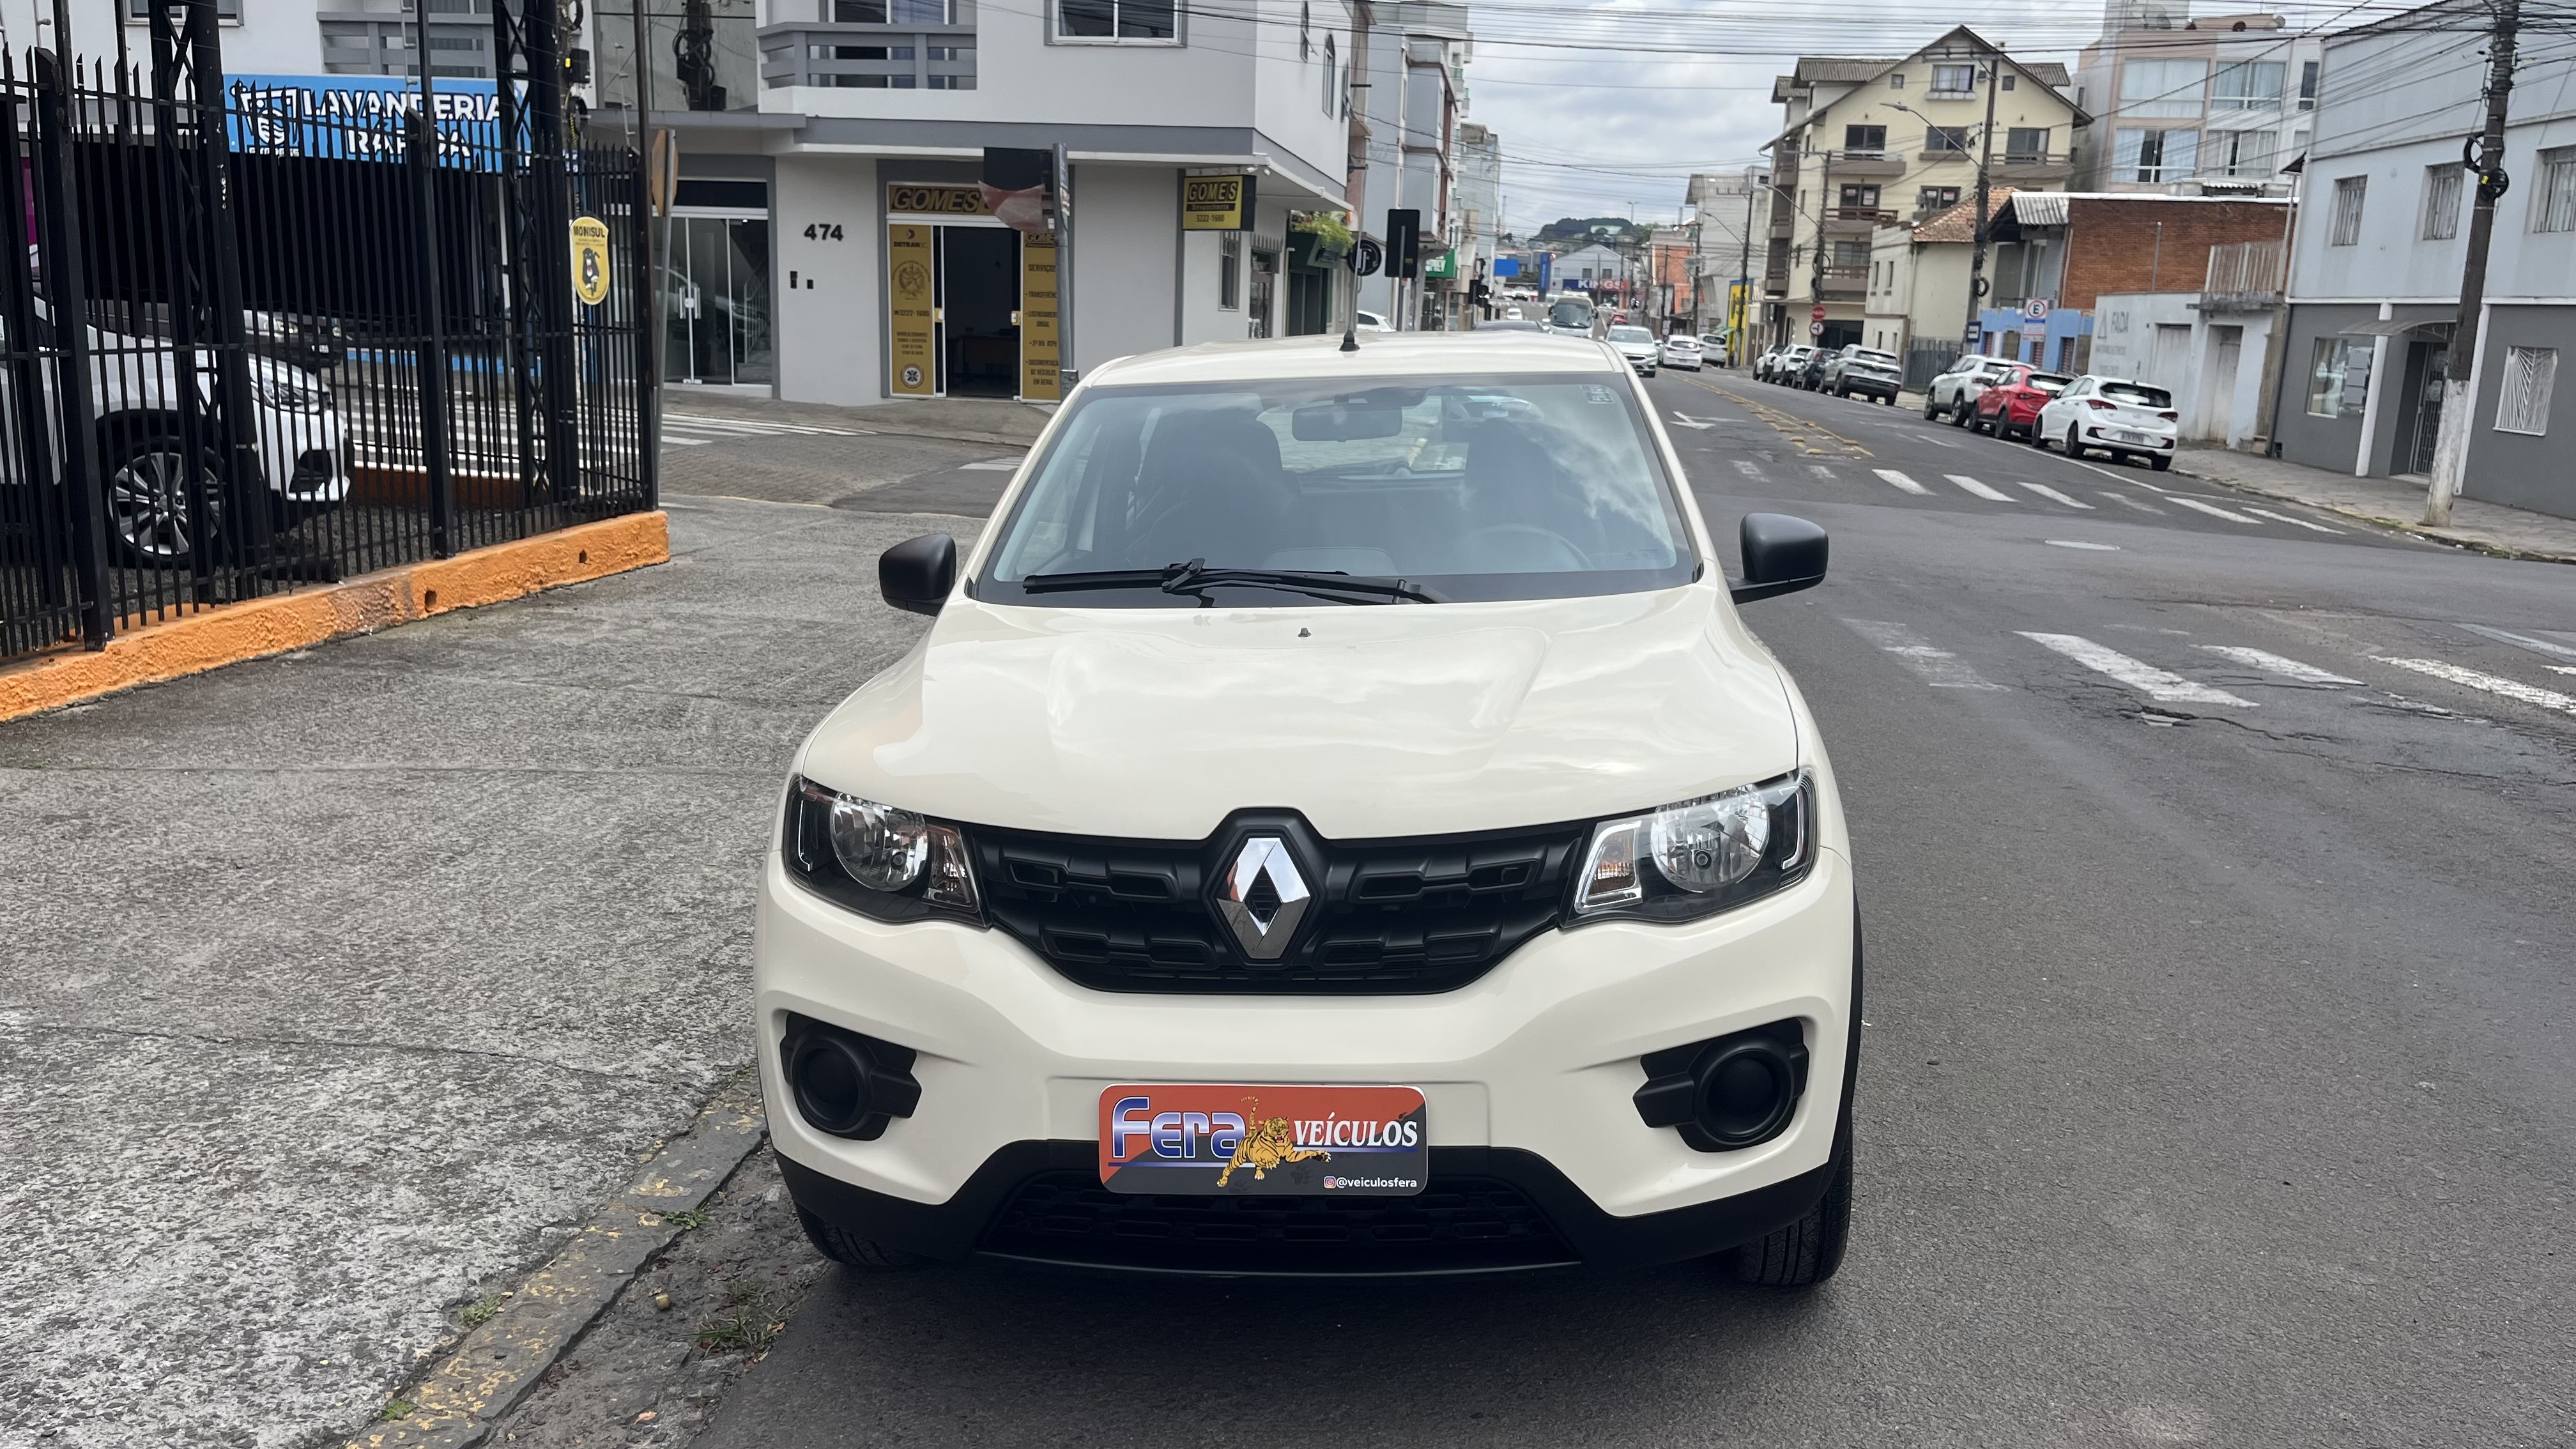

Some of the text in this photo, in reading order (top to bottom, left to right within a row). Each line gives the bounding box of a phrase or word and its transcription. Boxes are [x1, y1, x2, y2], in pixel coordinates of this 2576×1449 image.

[893, 187, 982, 212] GOMES
[1189, 183, 1238, 201] GOMES
[573, 226, 606, 238] MONISUL
[804, 223, 844, 241] 474
[2033, 304, 2040, 314] E
[1112, 1096, 1418, 1158] Fera VEÍCULOS
[1336, 1176, 1418, 1188] @veiculosfera
